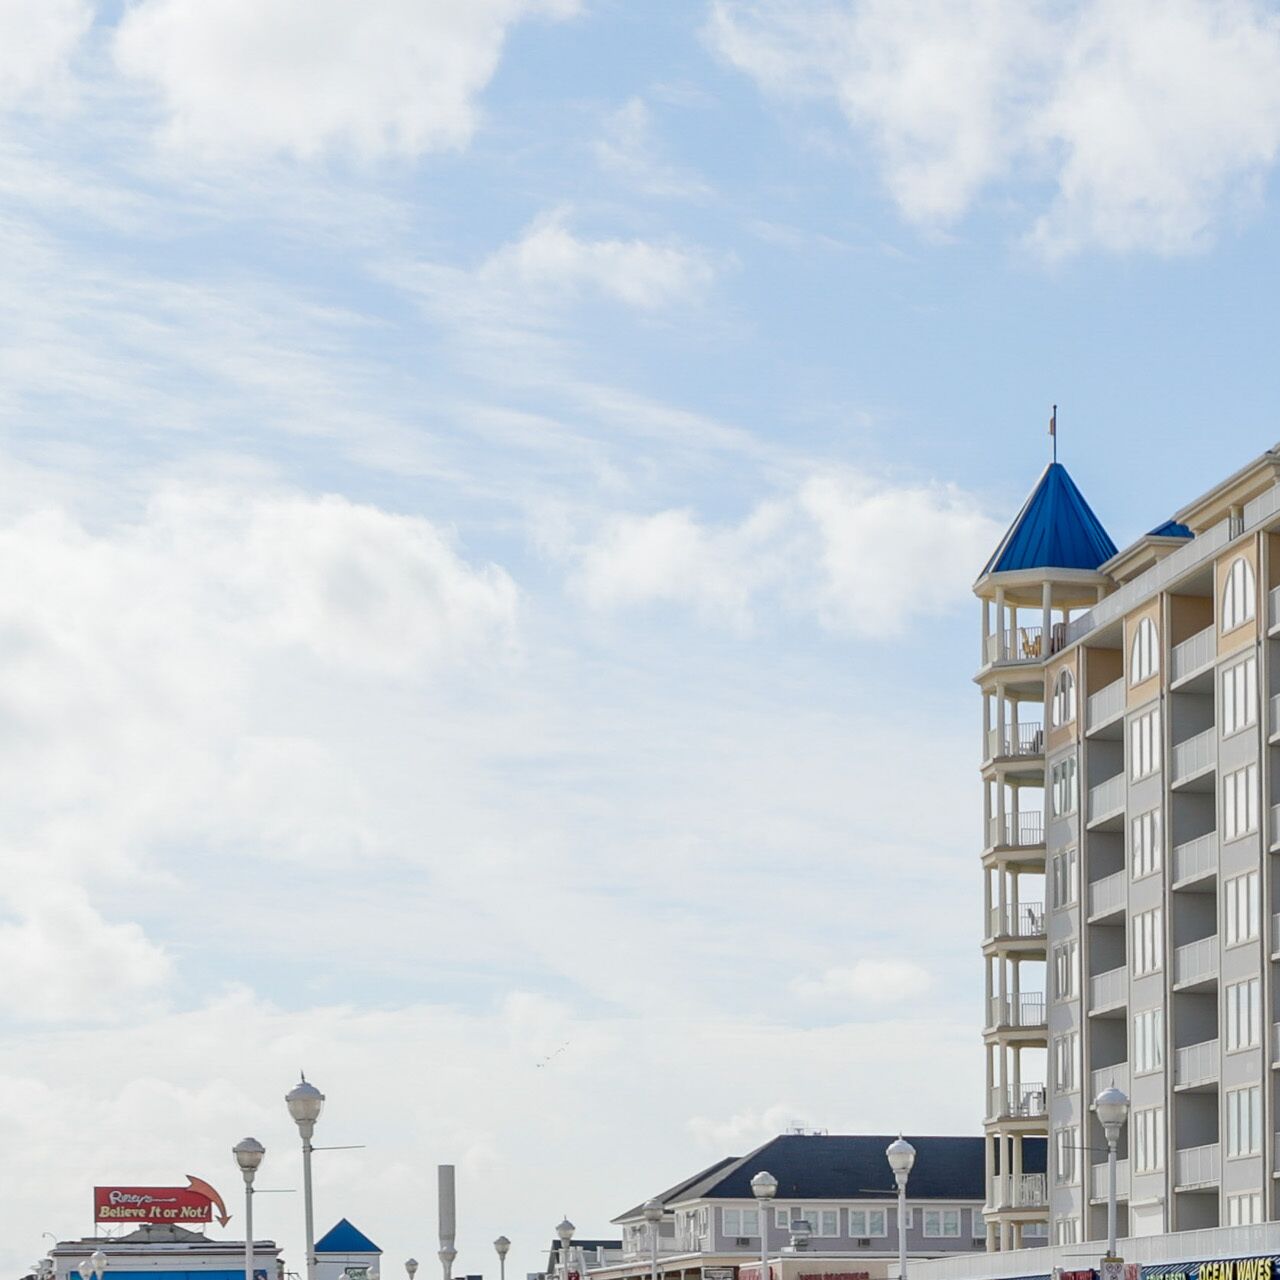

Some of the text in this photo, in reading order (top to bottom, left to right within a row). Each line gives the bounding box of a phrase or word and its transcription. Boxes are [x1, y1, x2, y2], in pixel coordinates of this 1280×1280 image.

[99, 1205, 209, 1218] Believe It or Not!
